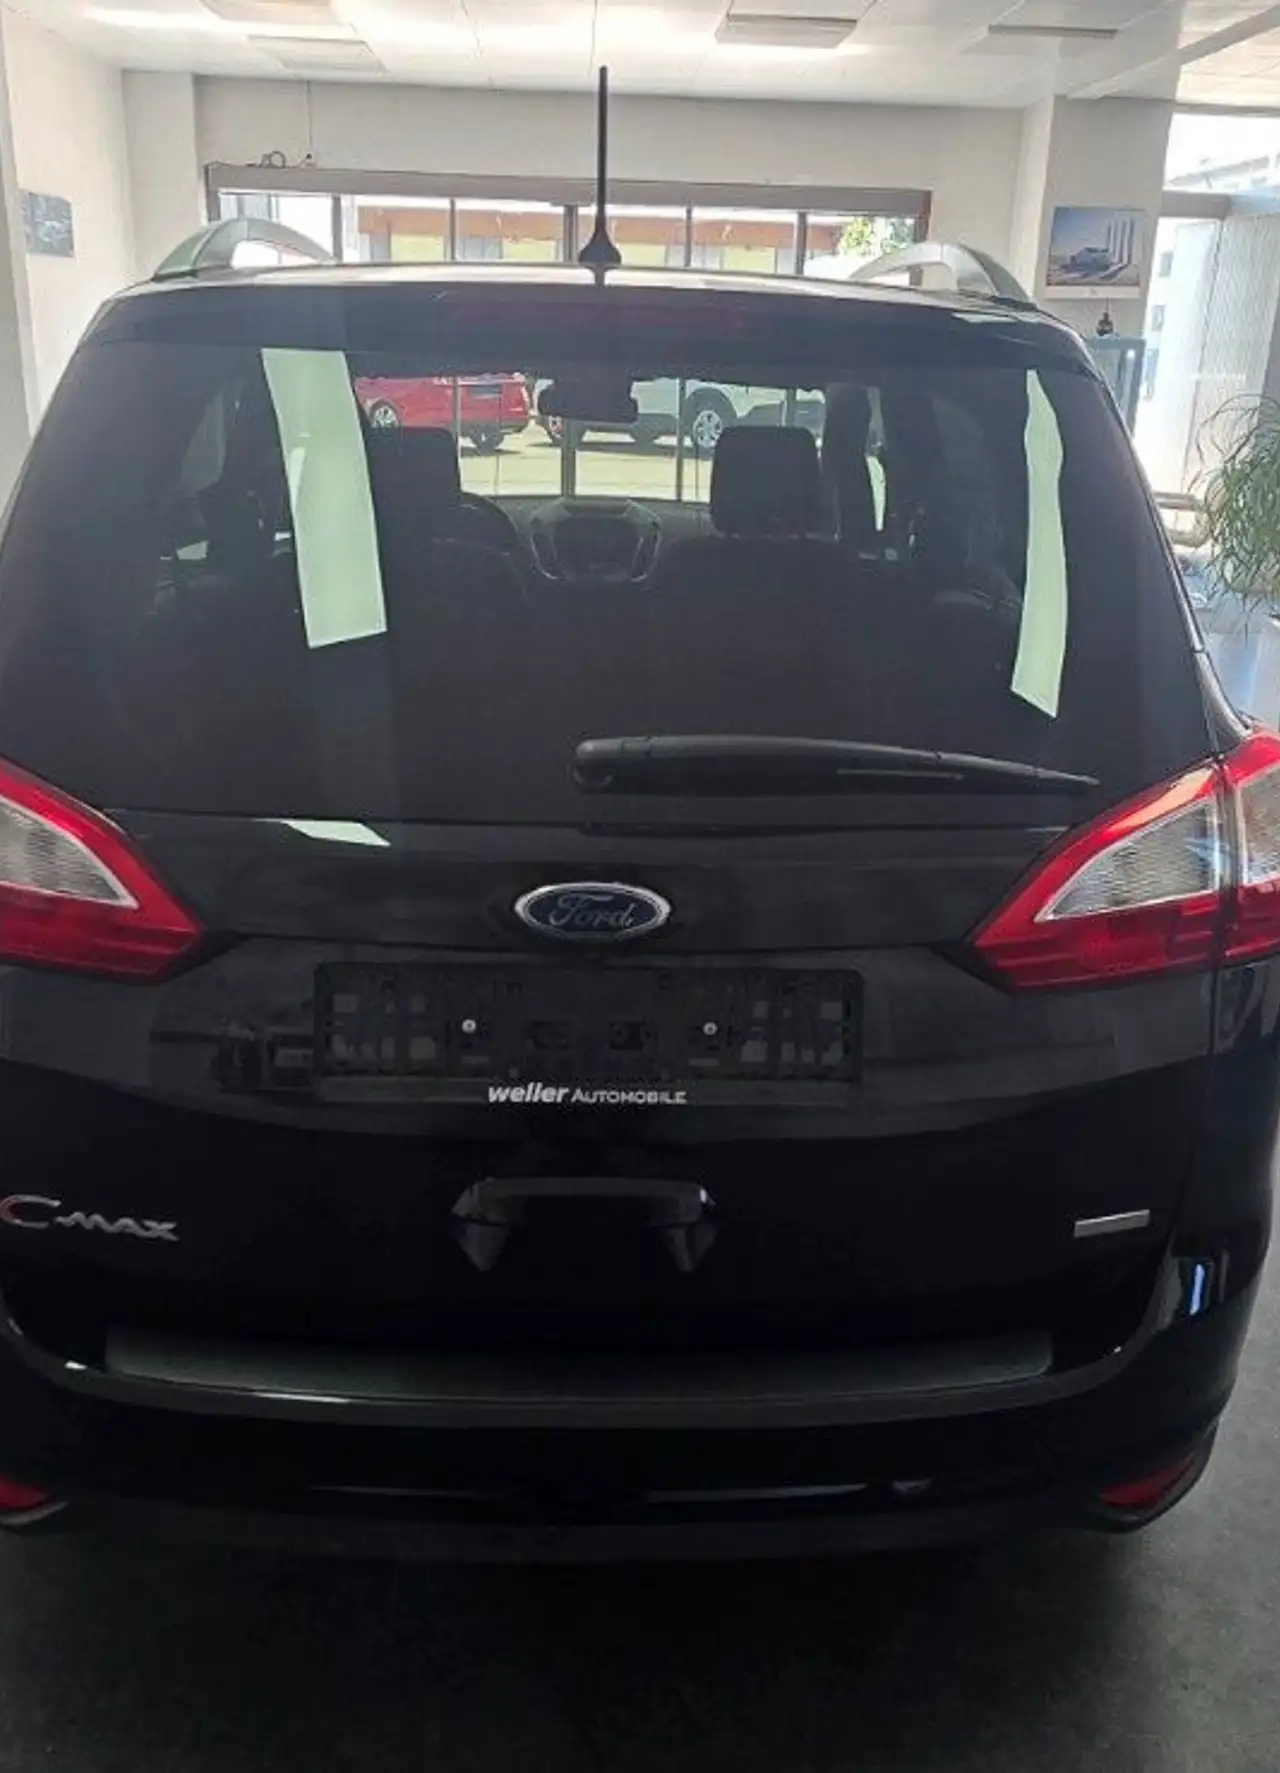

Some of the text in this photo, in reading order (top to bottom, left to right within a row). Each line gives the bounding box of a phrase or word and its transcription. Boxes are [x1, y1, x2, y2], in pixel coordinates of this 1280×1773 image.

[548, 893, 636, 928] Ford
[488, 1081, 687, 1105] weller AUTOMOBILE
